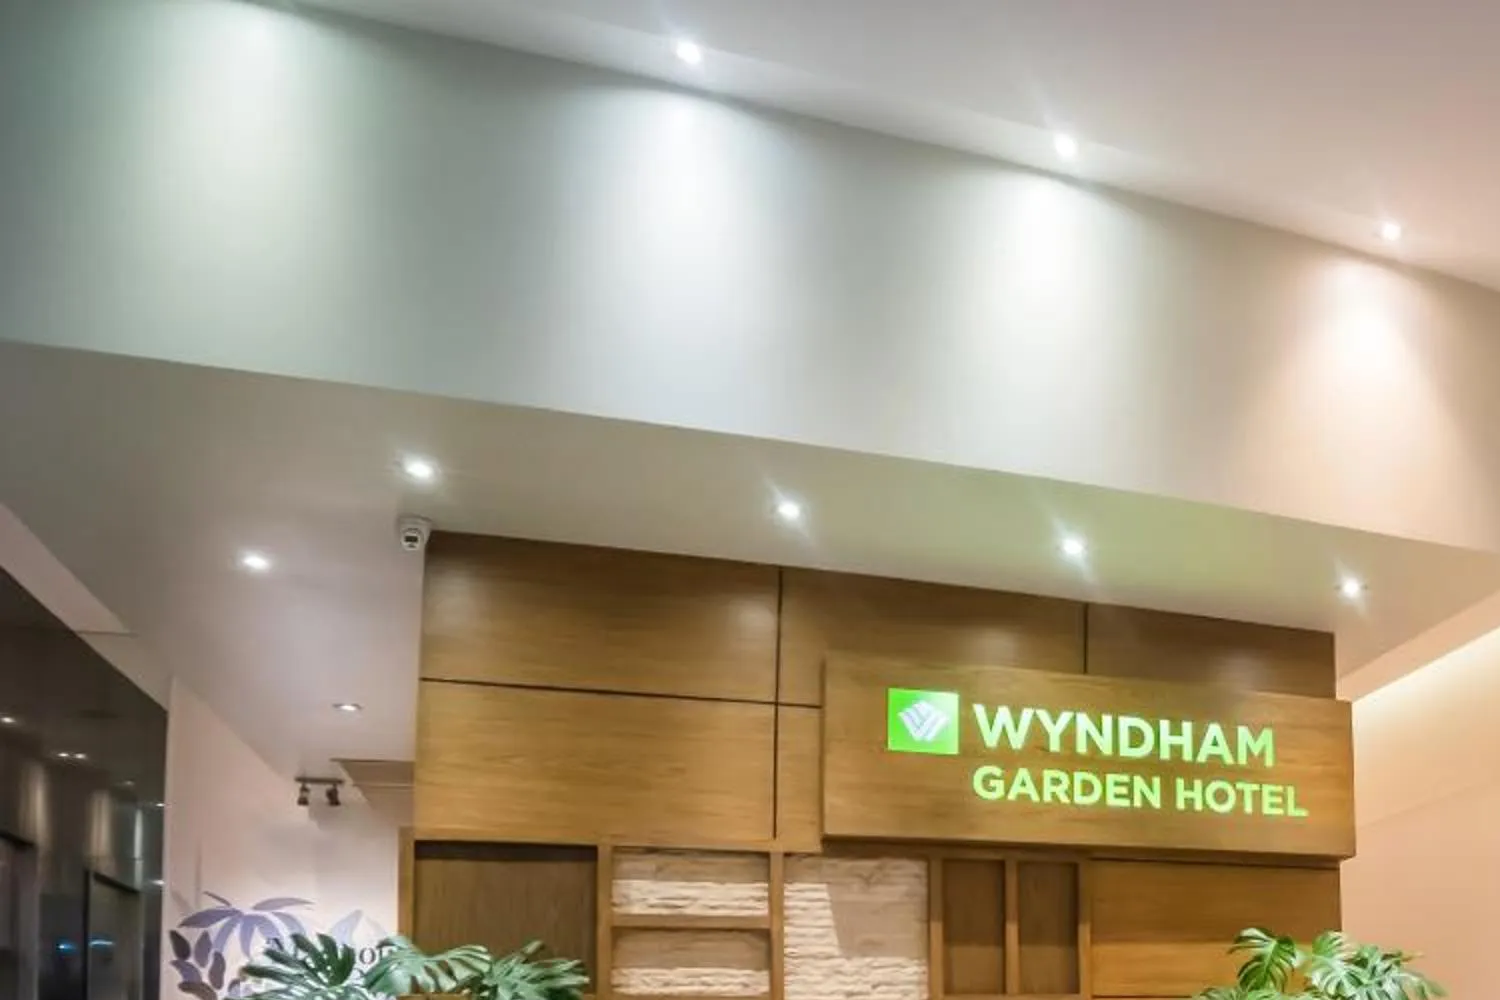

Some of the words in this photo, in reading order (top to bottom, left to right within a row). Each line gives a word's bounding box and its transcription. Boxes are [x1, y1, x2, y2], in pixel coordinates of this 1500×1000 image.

[973, 704, 1275, 767] WYNDHAM
[972, 767, 1161, 808] GARDEN
[1176, 778, 1308, 817] HOTEL
